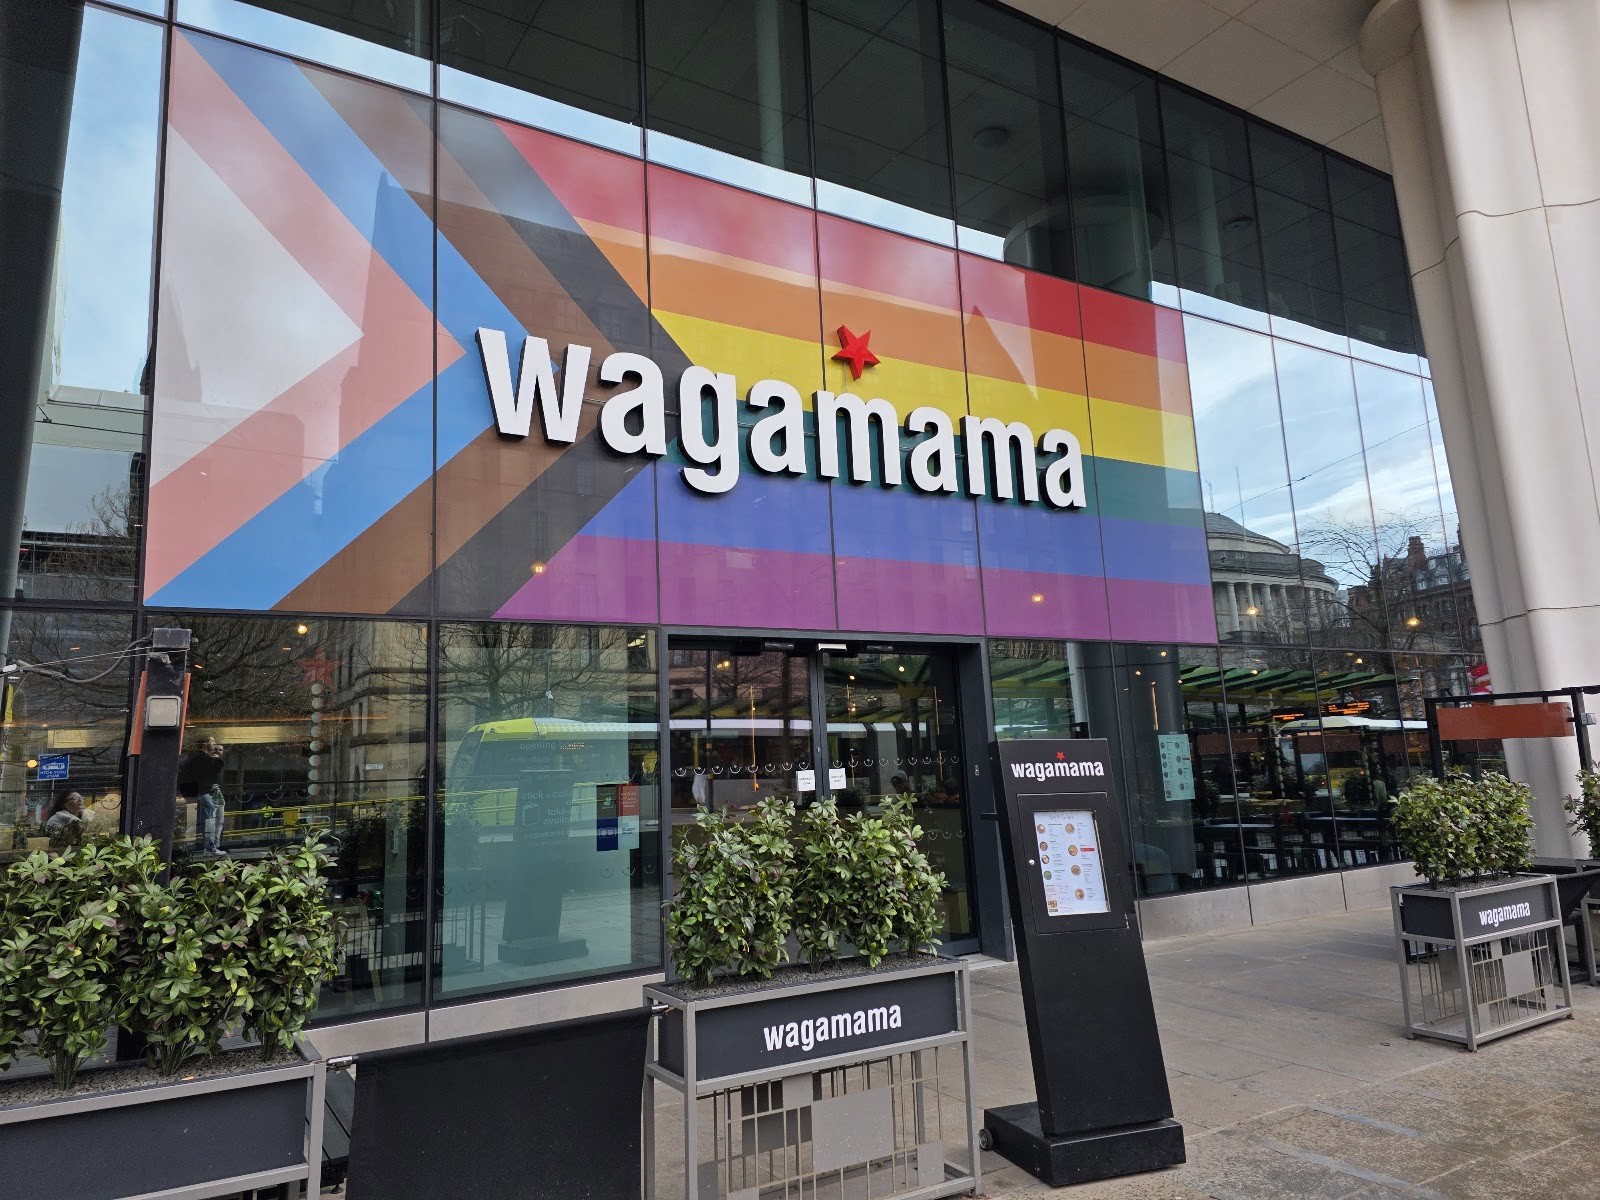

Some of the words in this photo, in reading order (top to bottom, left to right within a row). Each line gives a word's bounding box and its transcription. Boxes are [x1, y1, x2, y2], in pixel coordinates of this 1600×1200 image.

[474, 327, 1088, 511] wagamama
[520, 741, 556, 751] opening
[1011, 761, 1104, 781] wagamama
[522, 791, 544, 800] click
[1479, 902, 1530, 927] wagamama
[763, 1004, 902, 1052] wagamama
